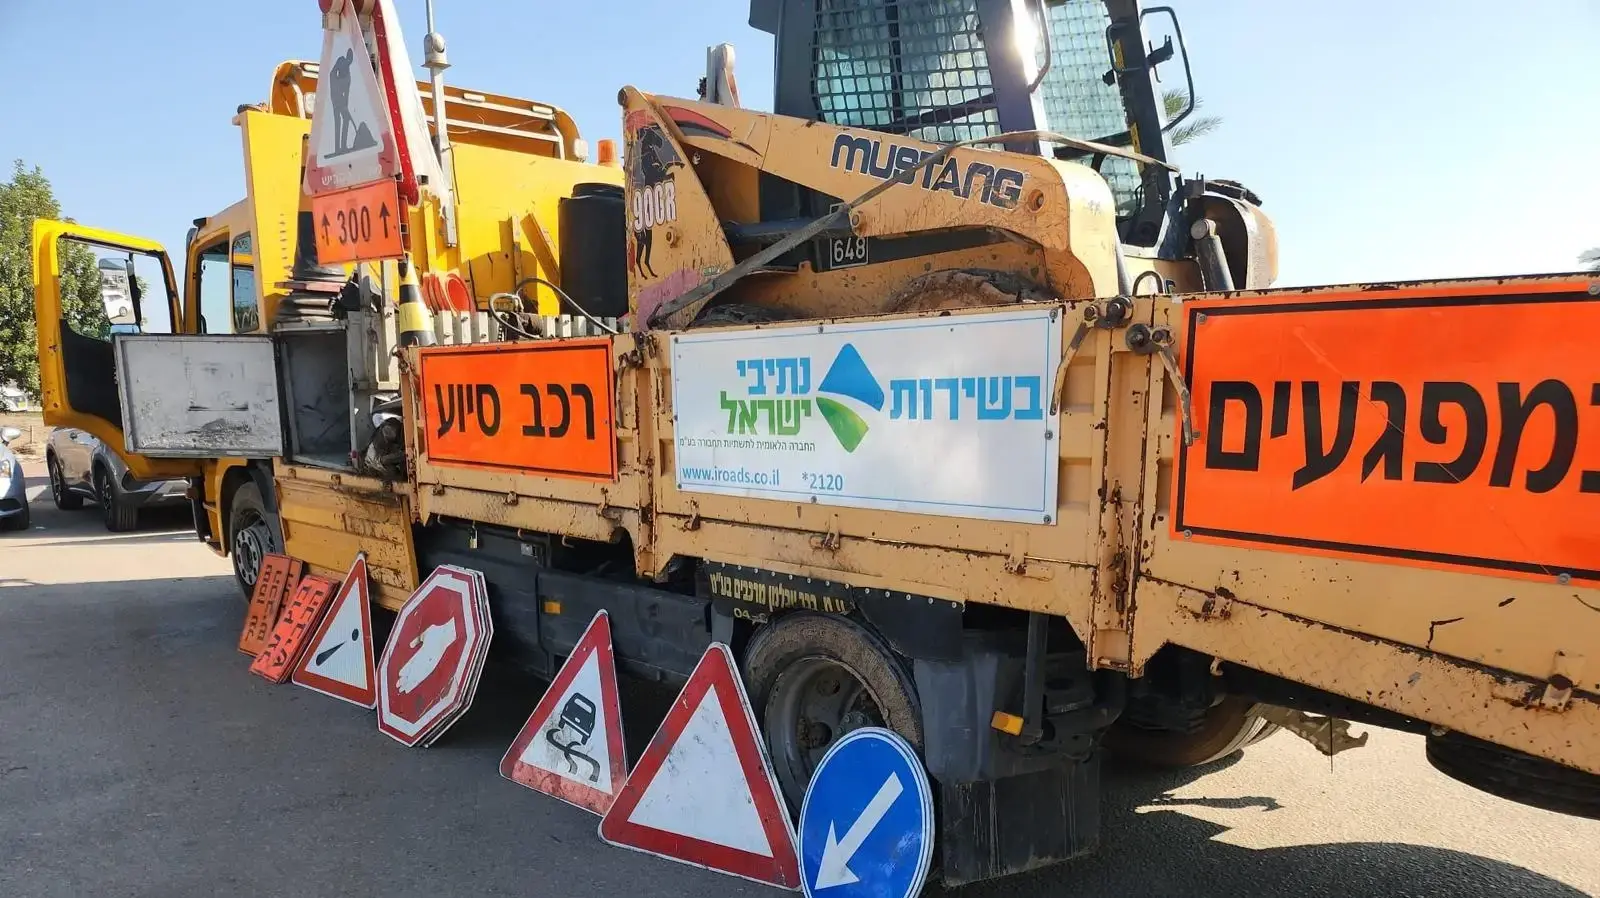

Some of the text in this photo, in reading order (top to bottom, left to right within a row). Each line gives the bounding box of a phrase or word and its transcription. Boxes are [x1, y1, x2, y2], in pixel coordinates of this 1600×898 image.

[831, 133, 1025, 210] MUSTANG
[337, 205, 371, 245] 300
[834, 237, 866, 263] 648
[736, 357, 811, 396] נתיבי
[434, 383, 596, 440] רכב סיוע
[720, 391, 812, 436] ישראל
[889, 375, 1043, 421] בשירות
[697, 438, 723, 448] תחבורה
[724, 438, 755, 449] לתשתיות
[756, 439, 787, 451] הלאומית
[789, 441, 816, 452] החברה
[1206, 378, 1600, 494] מפגעים
[682, 466, 780, 486] www.iroads.co.il
[256, 564, 273, 604] שמן
[257, 570, 282, 641] הכביש
[271, 590, 324, 667] הכביש
